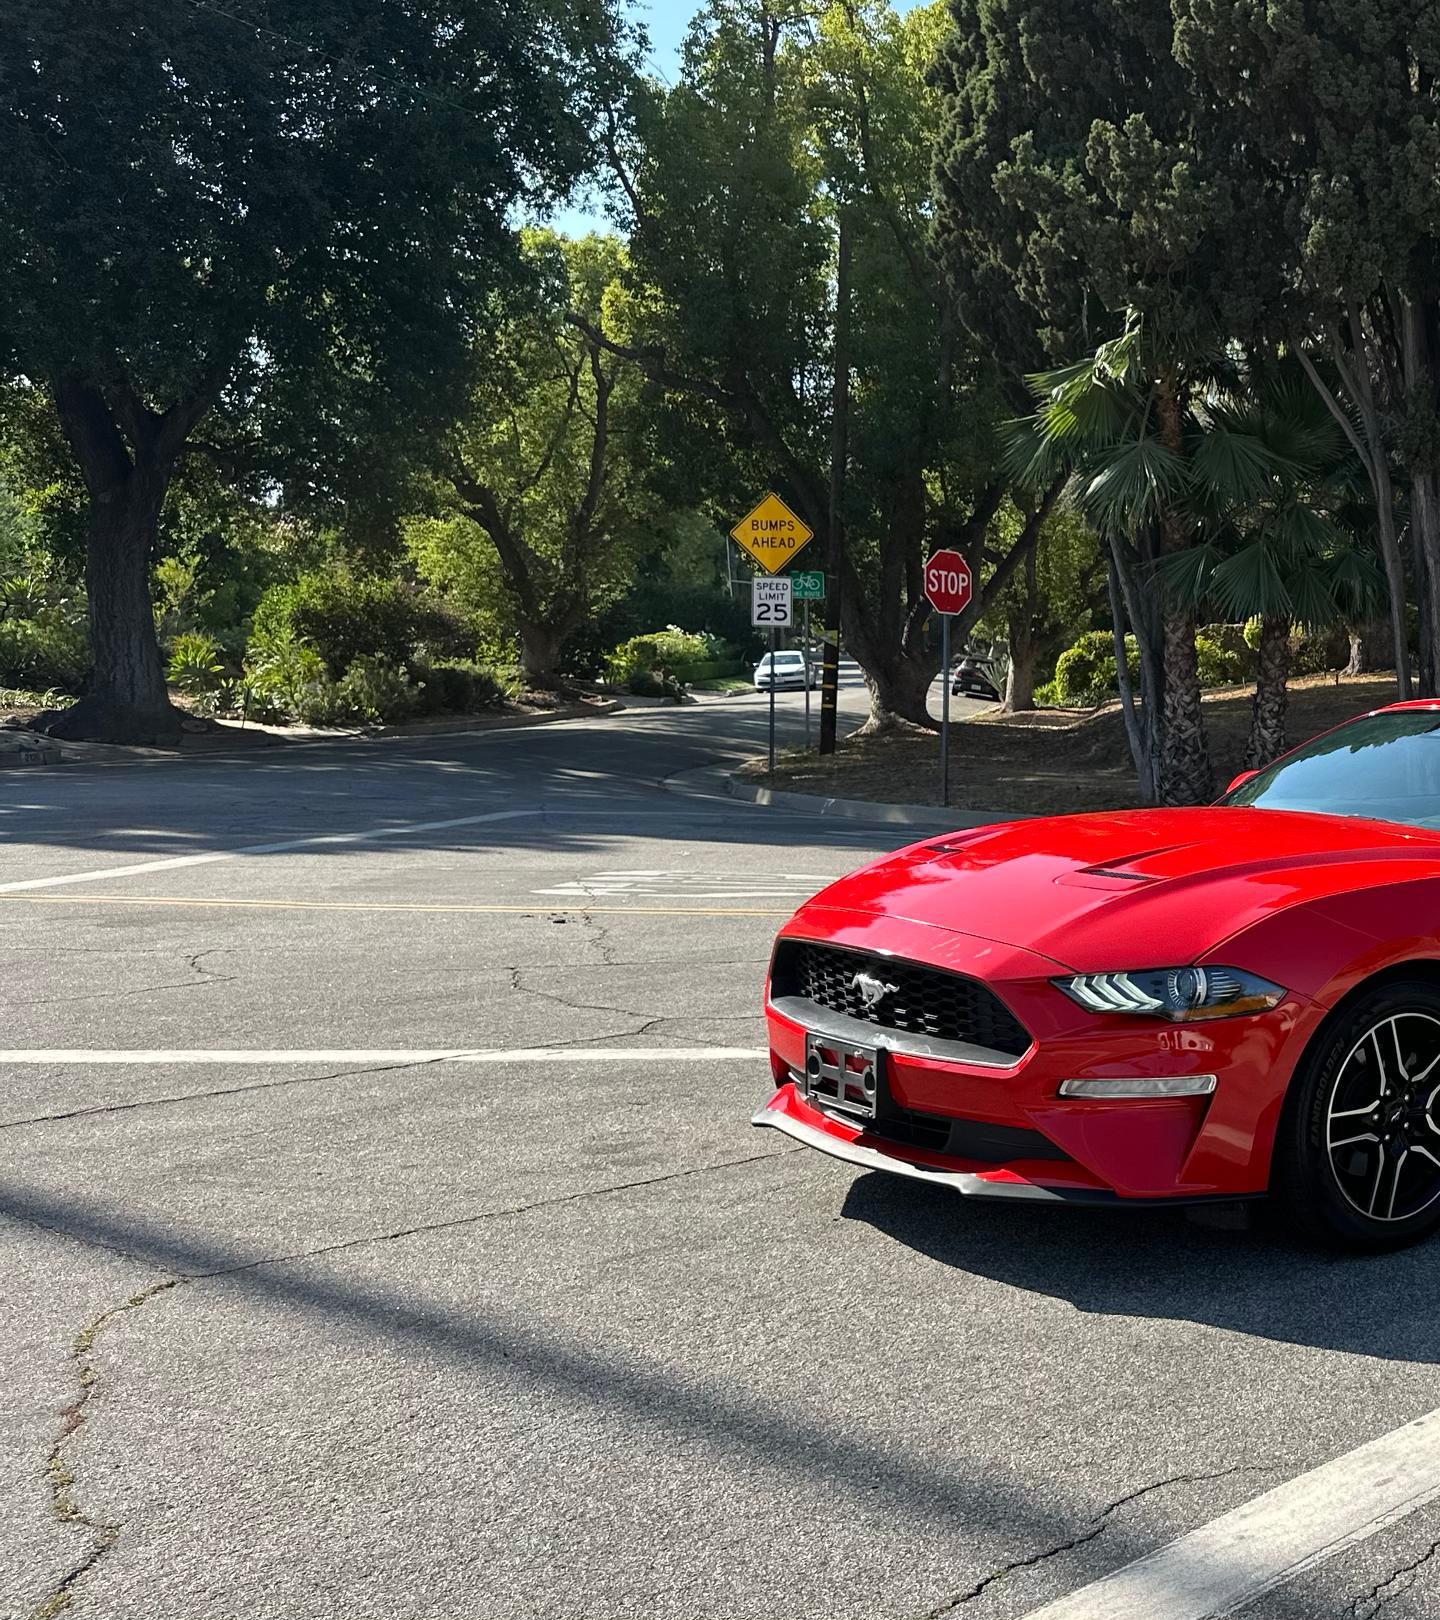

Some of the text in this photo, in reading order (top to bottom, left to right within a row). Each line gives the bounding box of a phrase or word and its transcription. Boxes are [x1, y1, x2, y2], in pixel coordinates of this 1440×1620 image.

[751, 519, 795, 532] BUMPS
[751, 537, 796, 549] AHEAD
[756, 582, 789, 591] SPEED
[928, 568, 969, 595] STOP
[759, 593, 785, 601] LIMIT
[756, 603, 788, 621] 25
